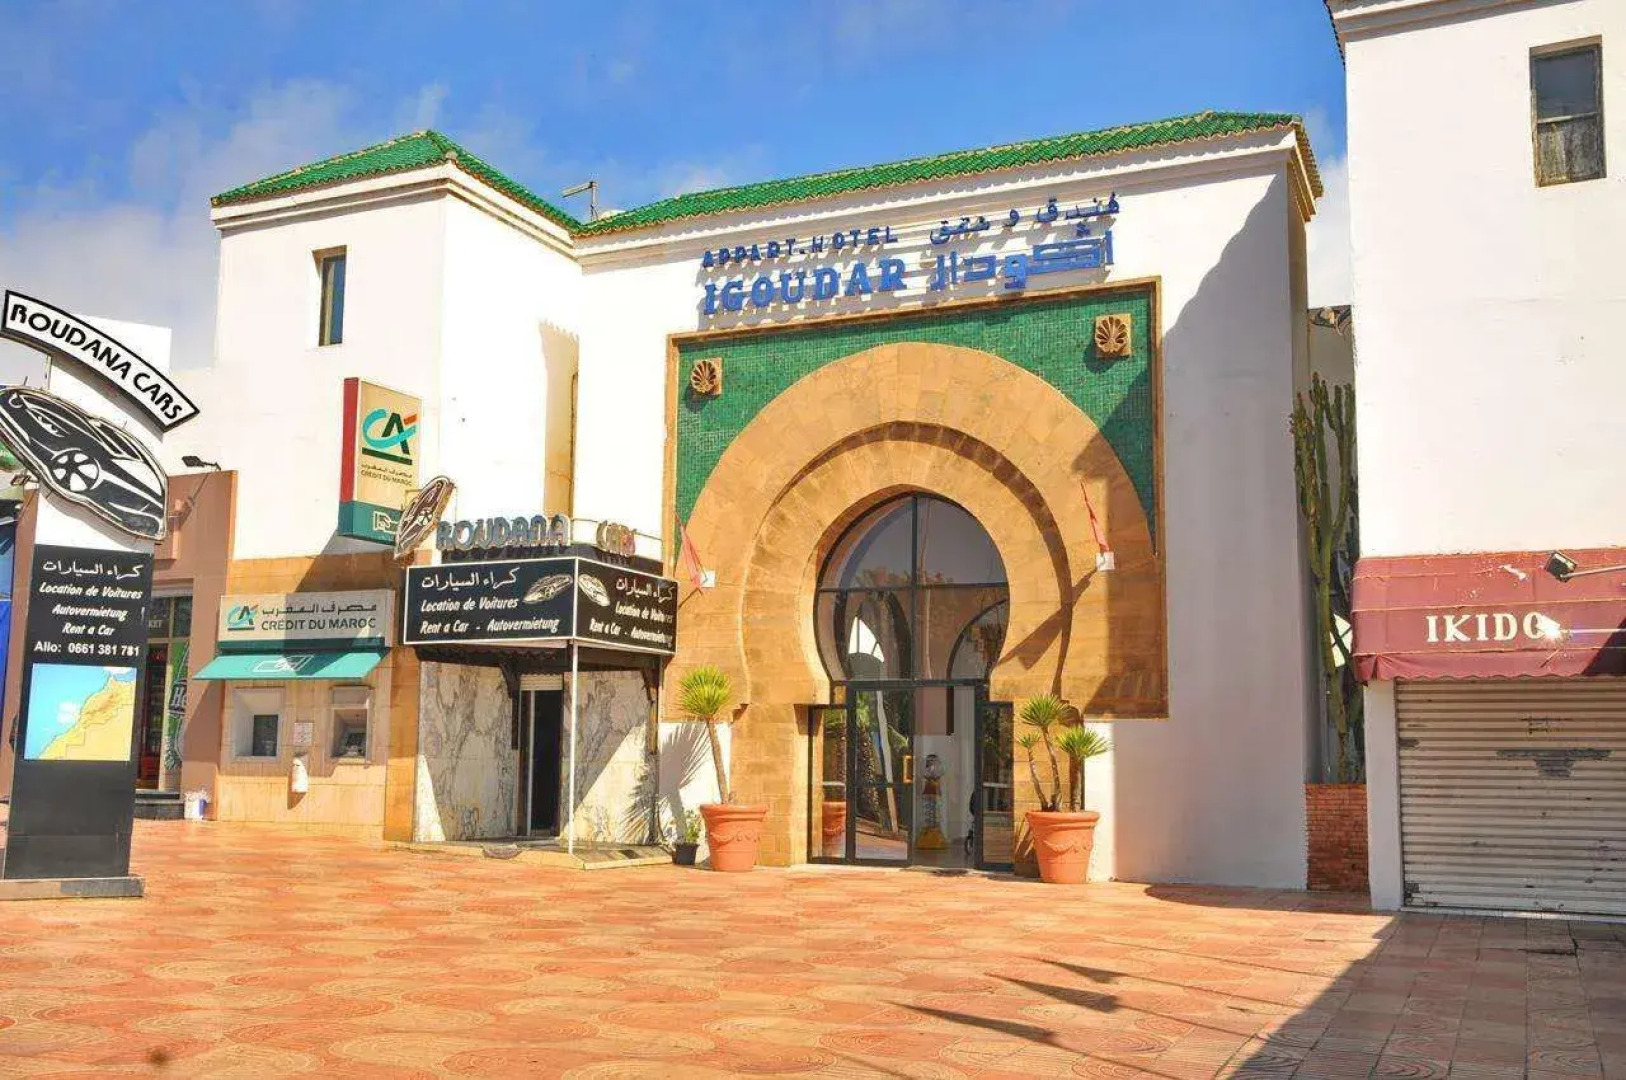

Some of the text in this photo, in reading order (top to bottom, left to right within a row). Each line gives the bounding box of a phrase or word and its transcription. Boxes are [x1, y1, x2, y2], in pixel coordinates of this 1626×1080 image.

[704, 257, 908, 316] IGOUDAR
[10, 303, 183, 420] ROUDANA CARS
[43, 560, 144, 580] كراء السيارات
[421, 567, 520, 591] كراء السيارات
[39, 581, 143, 600] Location de Voitures
[615, 577, 652, 598] السيارات
[52, 604, 128, 622] Autovermietung
[420, 597, 518, 612] Location de Voitures
[61, 622, 116, 636] Rent a Car
[308, 617, 326, 630] DU
[328, 617, 377, 630] MAROC
[420, 620, 443, 634] Rent
[444, 622, 451, 632] a
[453, 619, 469, 632] Car
[487, 616, 560, 633] Autovermietung
[33, 641, 62, 653] Allo:
[68, 643, 95, 654] 0661
[98, 643, 117, 656] 381
